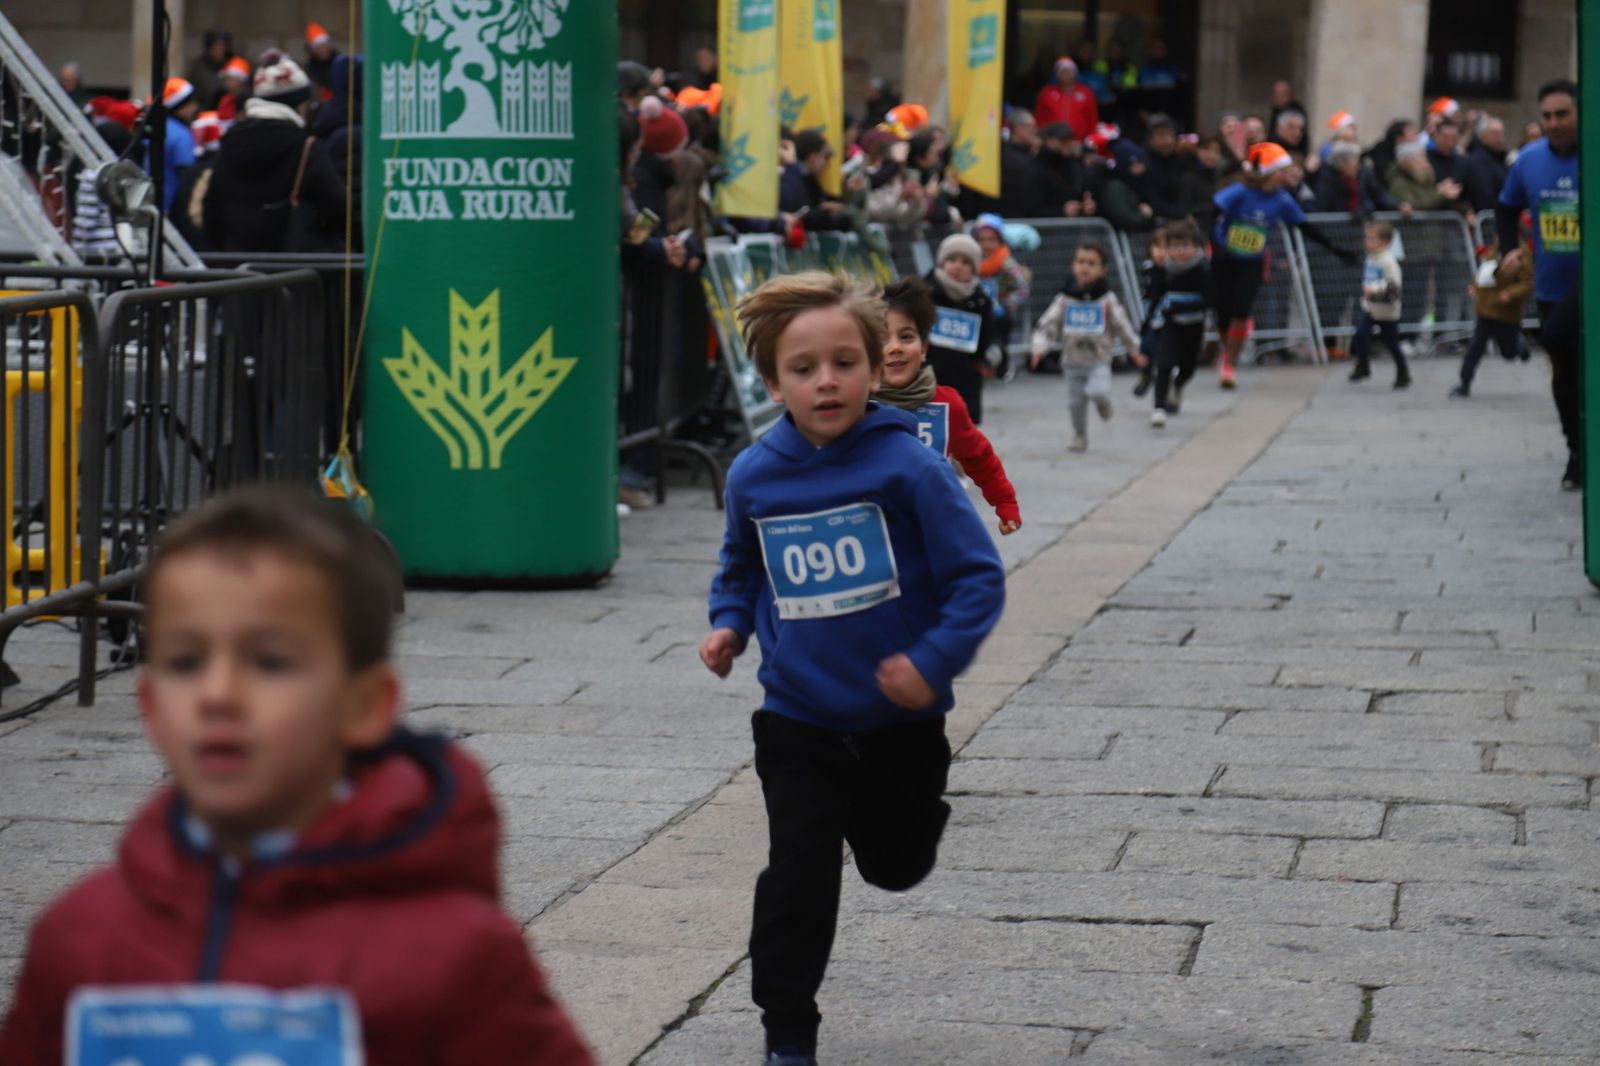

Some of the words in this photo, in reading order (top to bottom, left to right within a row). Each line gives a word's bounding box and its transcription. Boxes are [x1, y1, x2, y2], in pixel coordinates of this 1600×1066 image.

[383, 157, 574, 187] FUNDACION
[384, 190, 454, 221] CAJA
[461, 190, 574, 220] RURAL
[1544, 214, 1580, 237] 1147
[783, 535, 866, 585] 090
